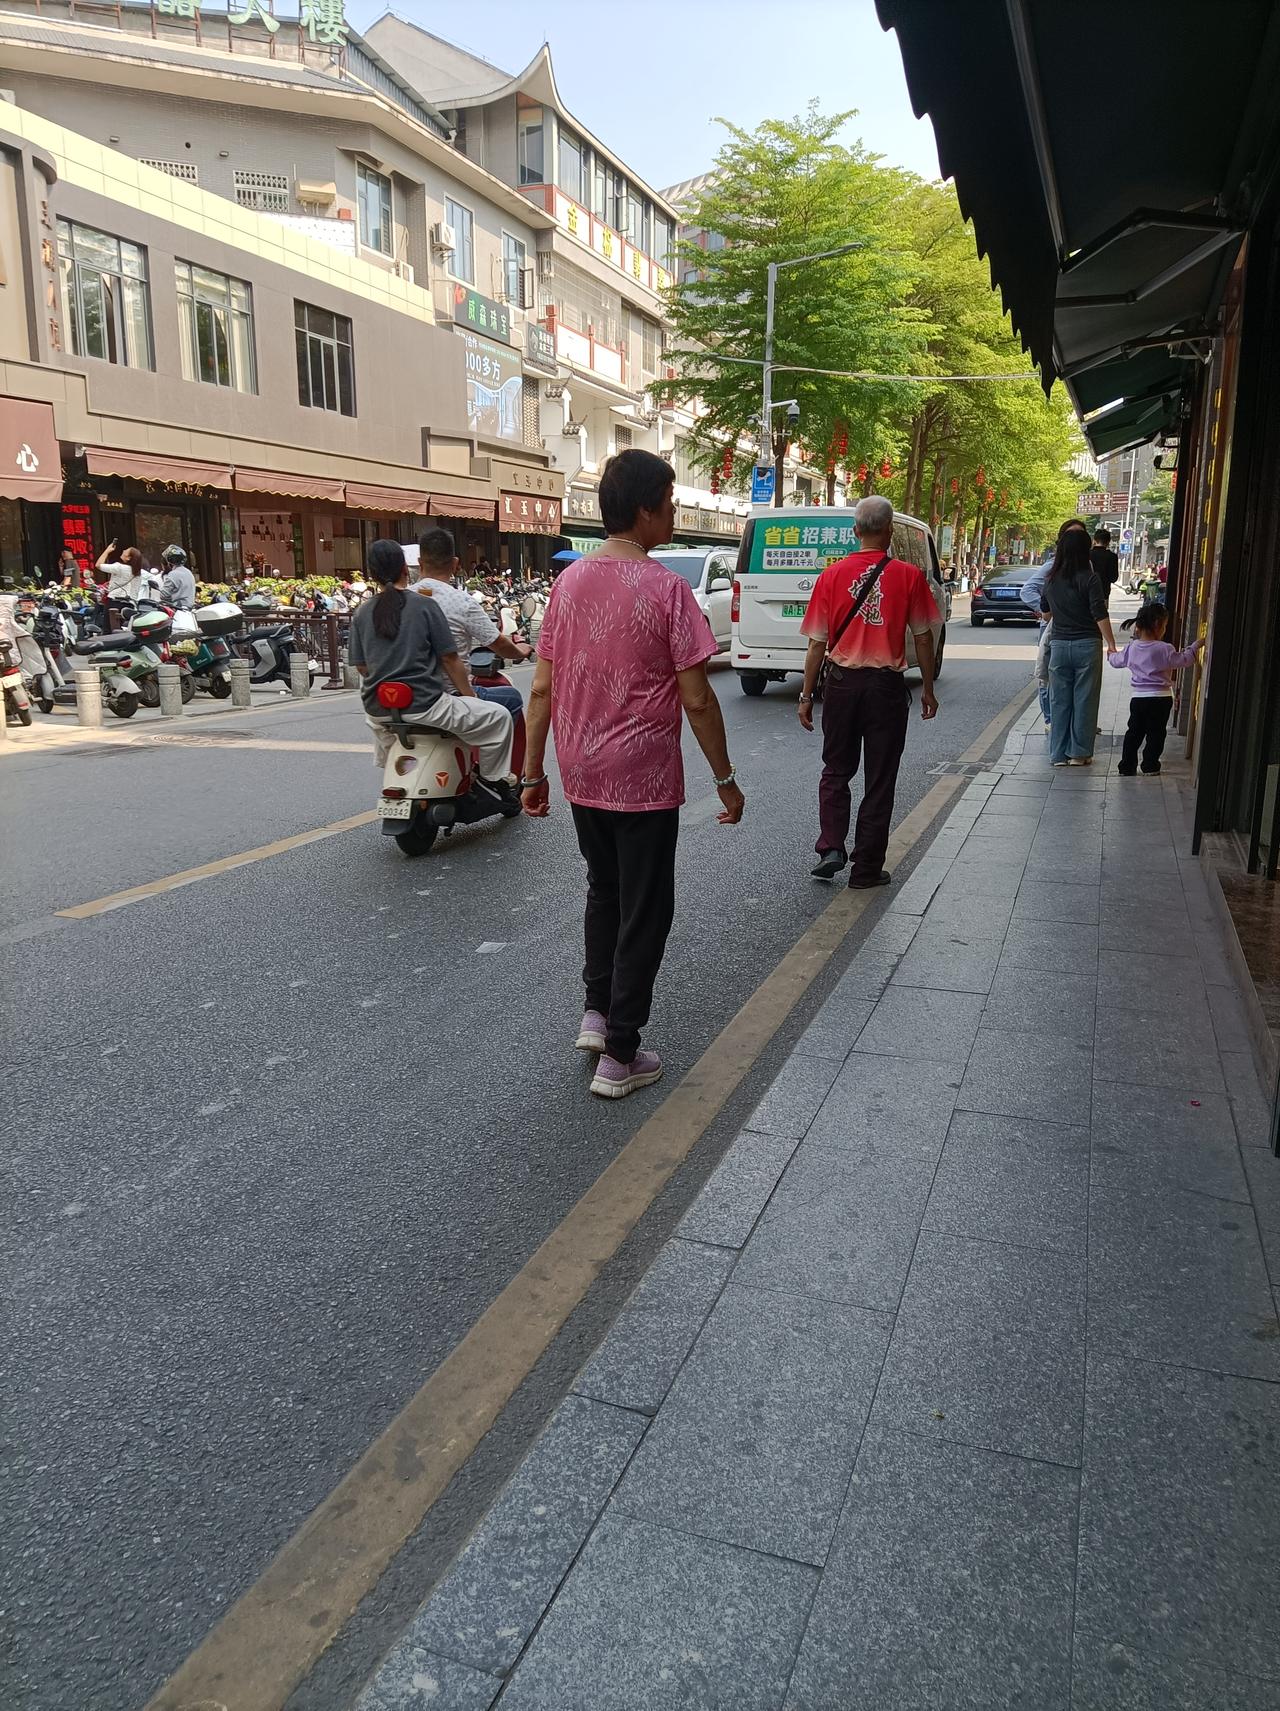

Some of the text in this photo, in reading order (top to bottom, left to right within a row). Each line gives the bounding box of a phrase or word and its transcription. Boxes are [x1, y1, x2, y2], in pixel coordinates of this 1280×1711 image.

[764, 525, 856, 546] 省省招兼职
